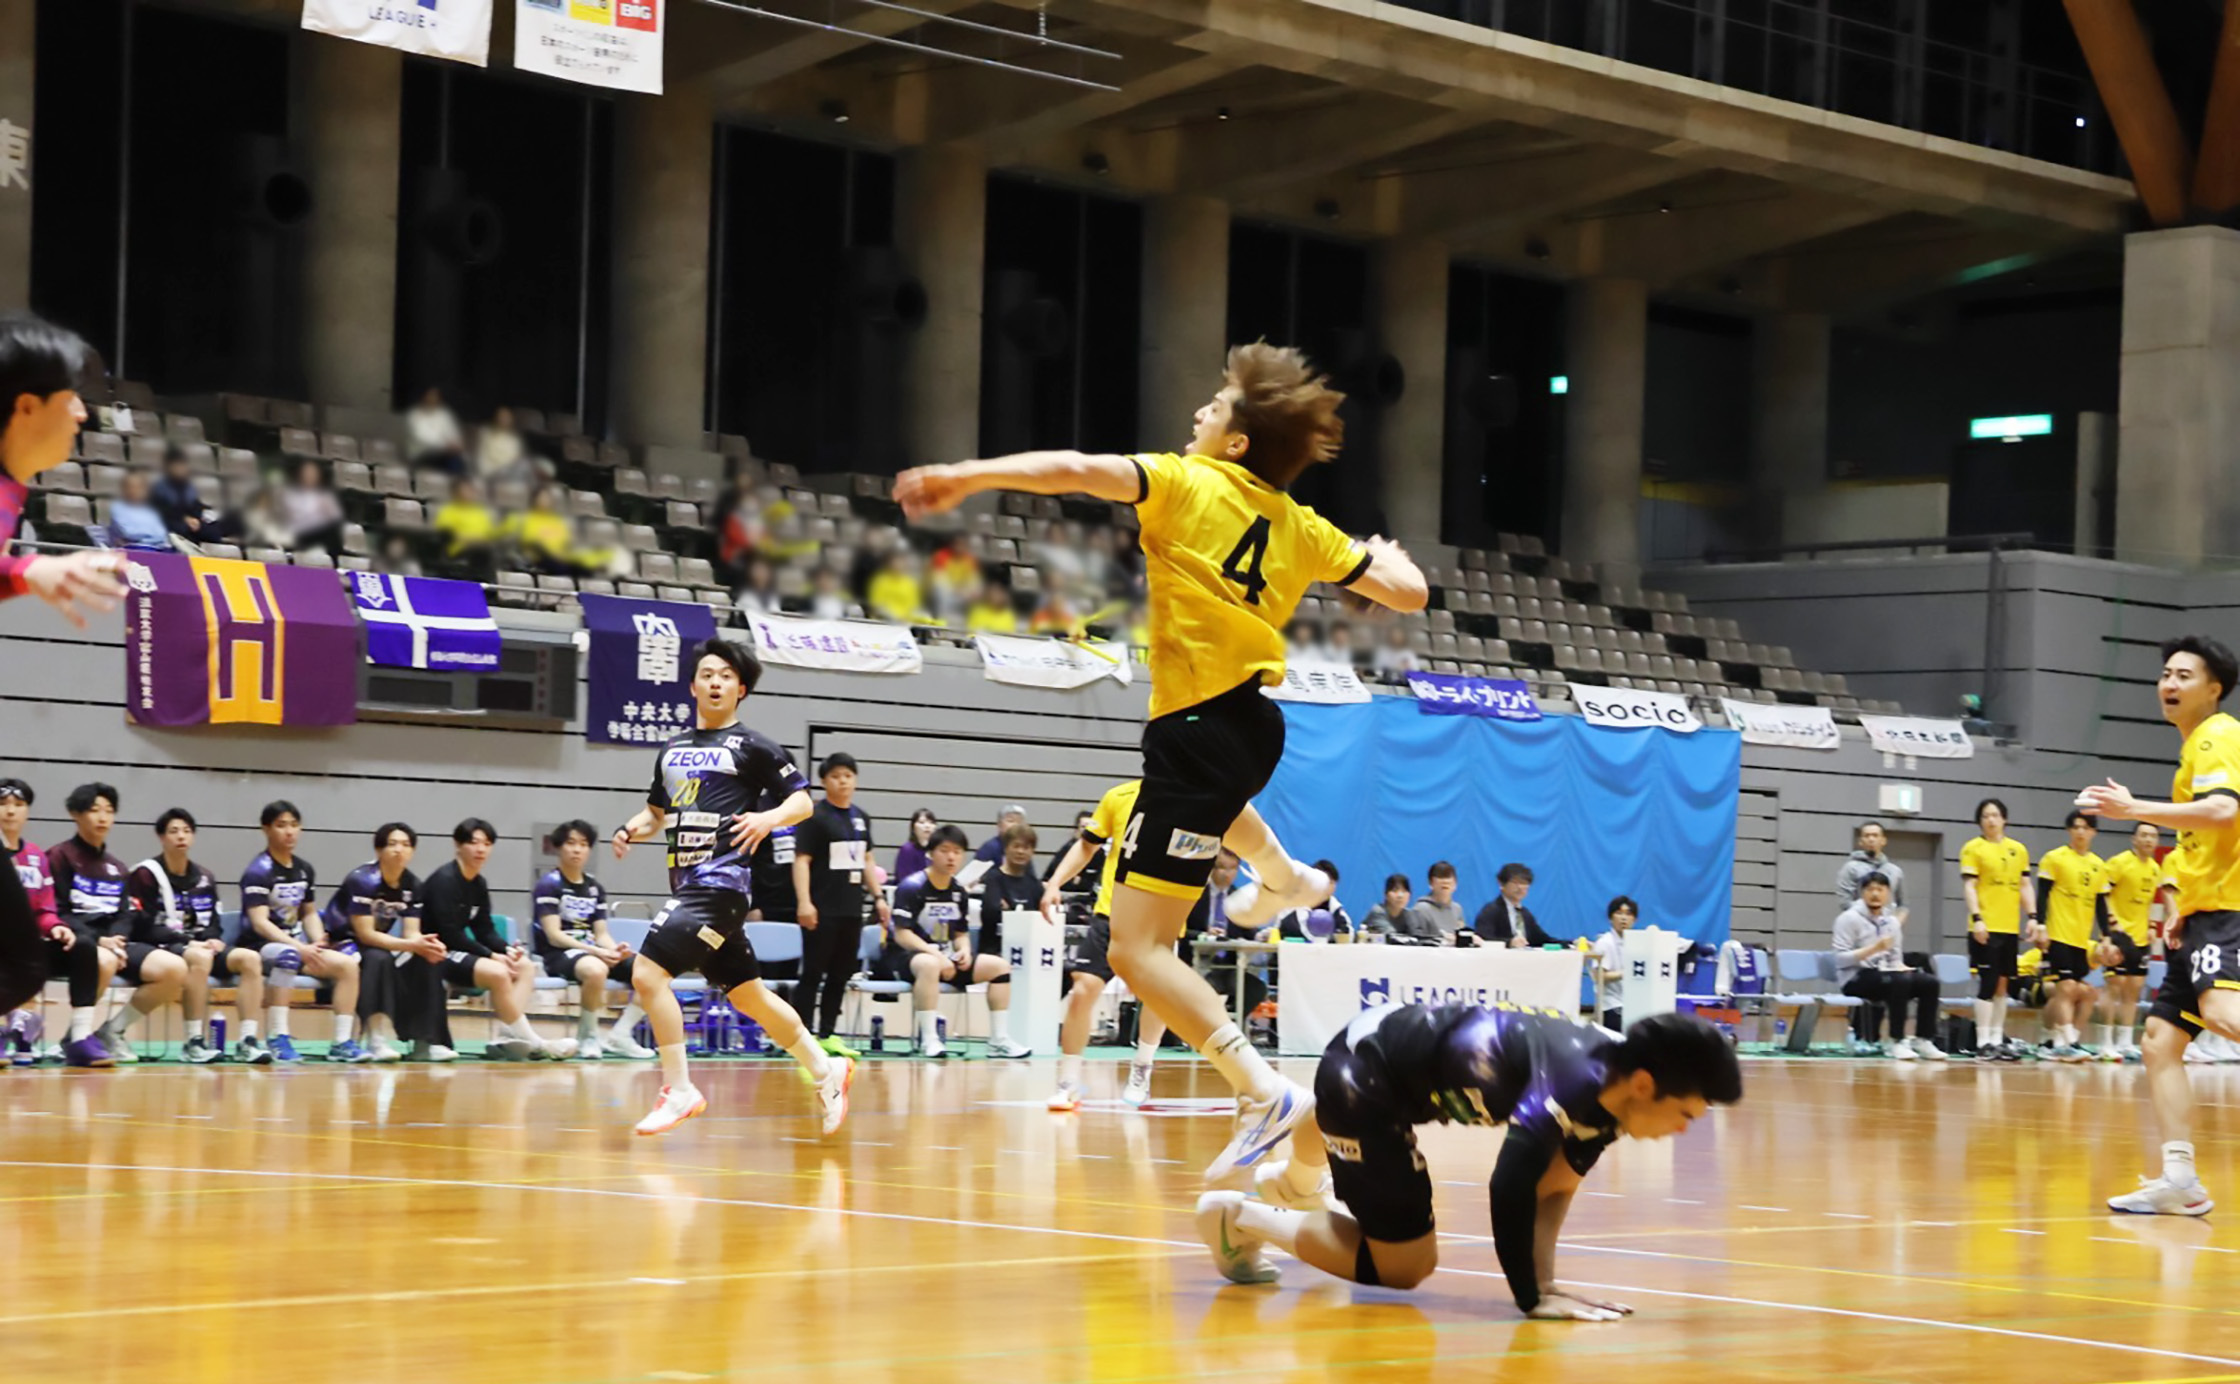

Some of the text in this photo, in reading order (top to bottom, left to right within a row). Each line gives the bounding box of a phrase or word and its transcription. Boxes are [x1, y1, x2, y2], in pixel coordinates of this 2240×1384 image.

[620, 3, 652, 20] BIG
[1221, 514, 1271, 606] 4
[623, 700, 691, 723] 中央大学
[1585, 701, 1687, 724] socio
[668, 751, 722, 767] ZEON
[1120, 811, 1145, 859] 4
[2190, 943, 2221, 984] 28
